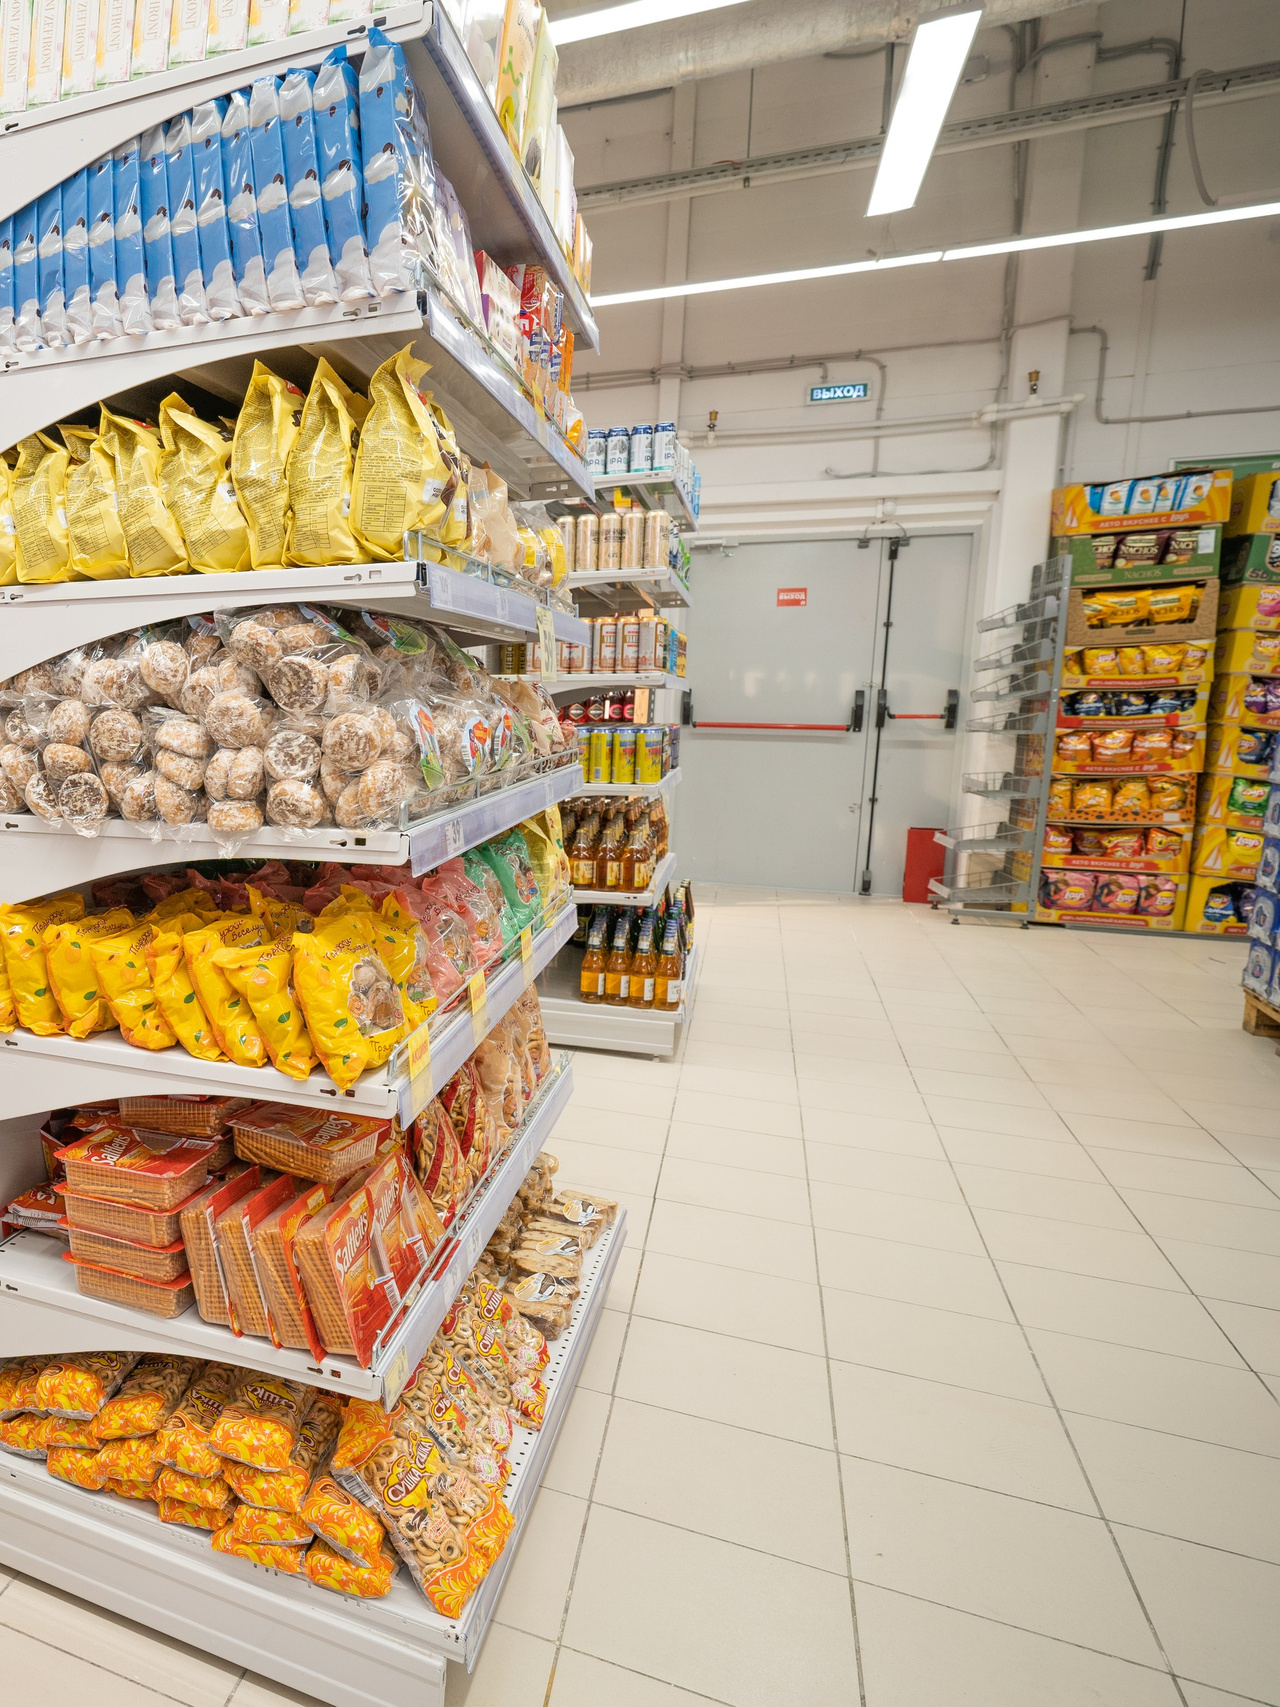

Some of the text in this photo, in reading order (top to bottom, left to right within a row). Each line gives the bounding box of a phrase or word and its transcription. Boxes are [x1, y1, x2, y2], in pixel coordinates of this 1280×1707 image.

[813, 384, 865, 400] ВЫХОД
[1099, 520, 1120, 528] ЛЕТО
[1122, 517, 1158, 526] ВКУСНЕЕ
[1121, 545, 1159, 554] NACHOS
[1124, 569, 1162, 579] NACHOS
[779, 592, 805, 600] ВЫХОД
[335, 1212, 369, 1286] Saltletts
[387, 1470, 421, 1501] СУШКА
